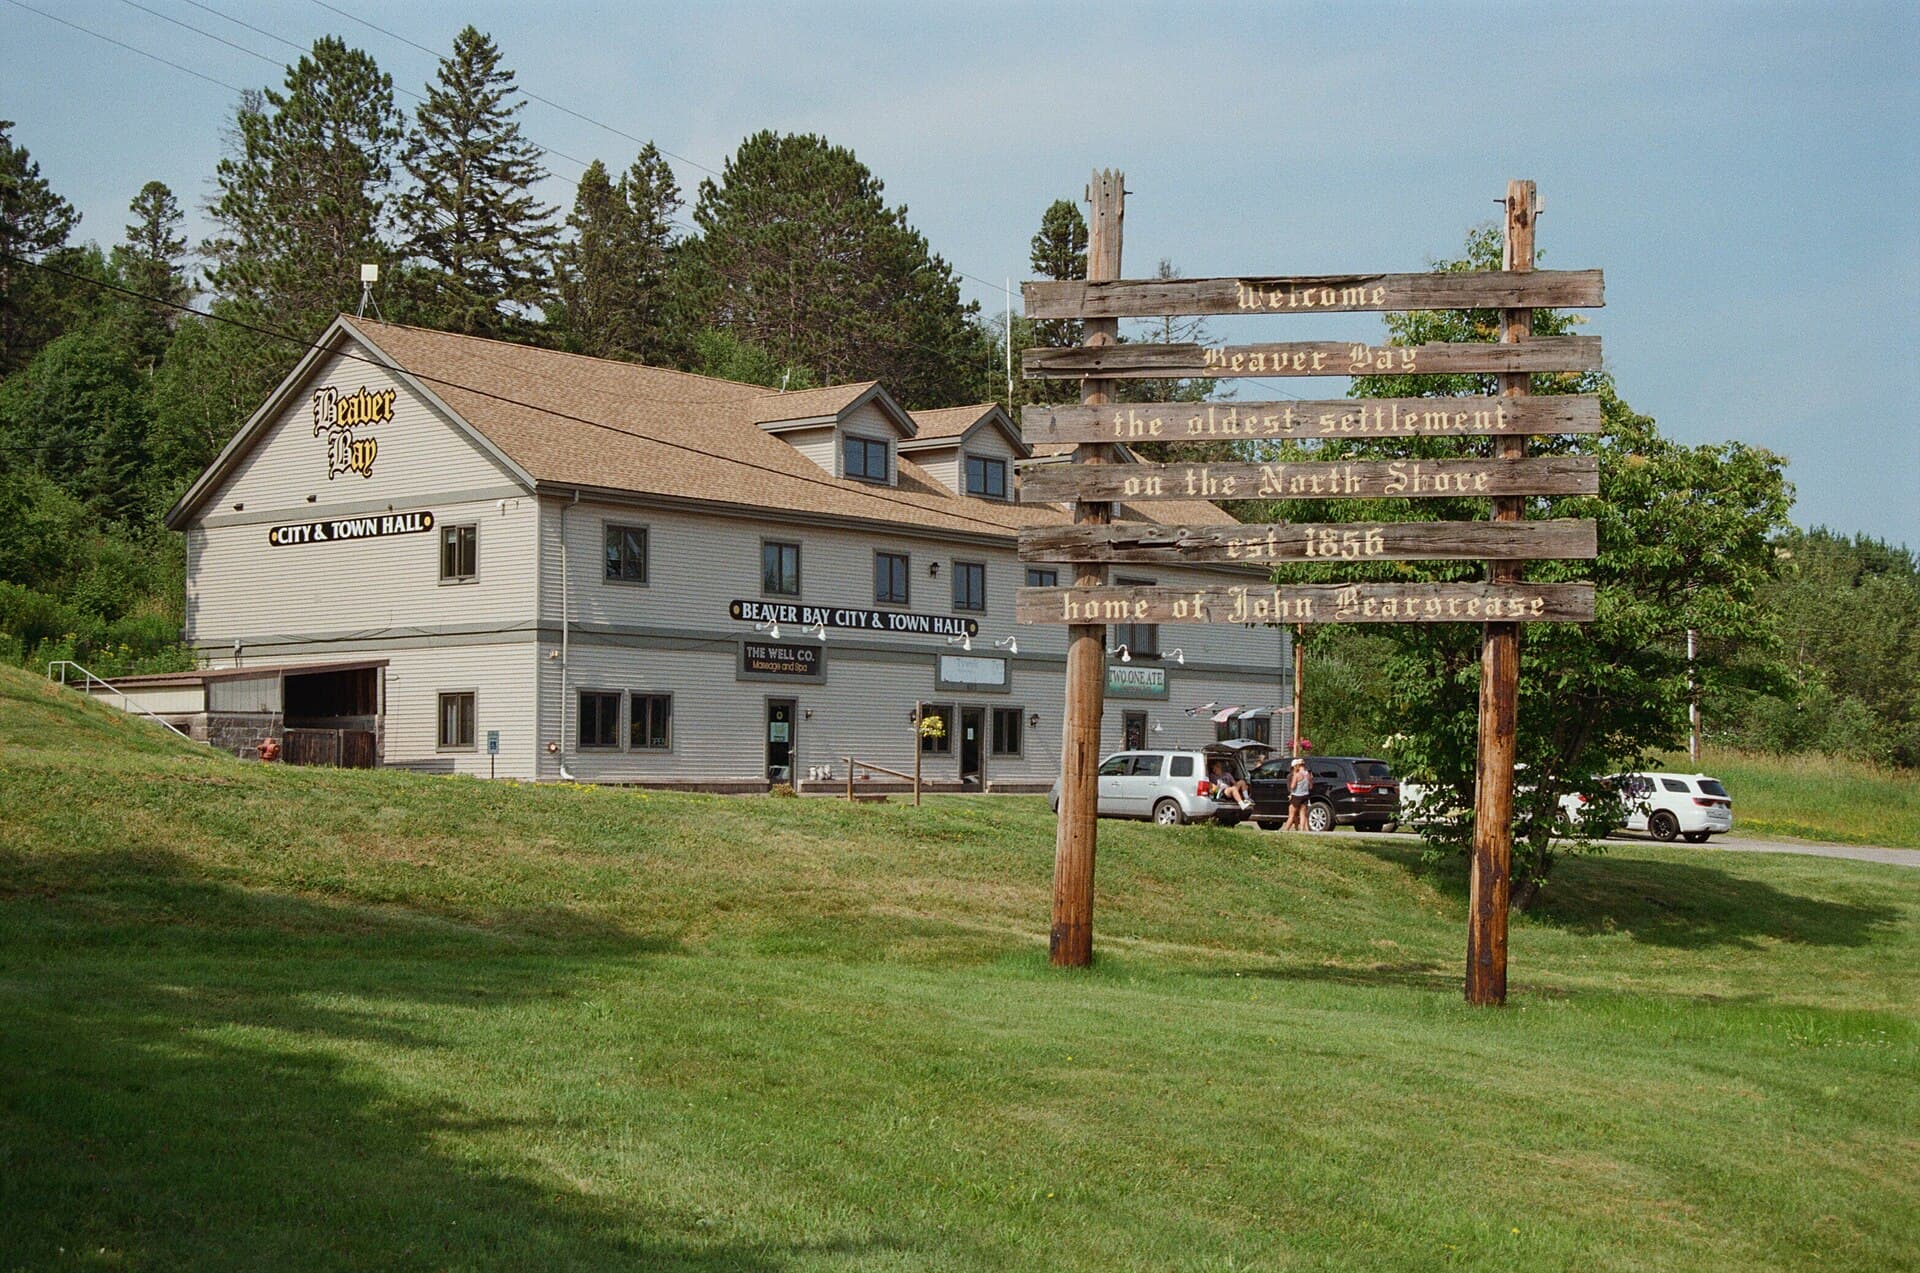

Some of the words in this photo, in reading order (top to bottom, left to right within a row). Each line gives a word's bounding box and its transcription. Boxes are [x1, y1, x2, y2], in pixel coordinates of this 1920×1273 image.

[1235, 281, 1386, 311] Welcome
[1202, 347, 1328, 376] Beaver
[1349, 343, 1418, 373] Bay
[313, 385, 396, 438] Beaver
[1113, 409, 1164, 437] the
[1187, 407, 1294, 435] oldest
[1319, 404, 1507, 433] settlement
[328, 428, 378, 480] Bay
[1123, 475, 1163, 496] on
[1185, 467, 1238, 496] the
[1258, 464, 1361, 498] North
[1384, 462, 1489, 494] Shore
[277, 523, 311, 544] CITY
[314, 523, 328, 541] &
[331, 518, 377, 537] TOWN
[382, 513, 423, 533] HALL
[1226, 531, 1278, 558] est
[1304, 527, 1385, 560] 1856
[742, 602, 798, 622] BEAVER
[803, 607, 830, 625] BAY
[835, 609, 867, 627] CITY
[872, 612, 884, 629] &
[888, 614, 929, 632] TOWN
[934, 617, 967, 634] HALL
[1063, 592, 1150, 621] home
[1172, 590, 1206, 618] of
[1228, 586, 1313, 623] John
[1335, 586, 1545, 620] Beargrease
[746, 646, 766, 659] THE
[768, 648, 795, 660] WELL
[797, 650, 815, 662] CO.
[781, 662, 794, 672] and
[794, 662, 808, 673] Spa
[1146, 671, 1163, 686] ATE
